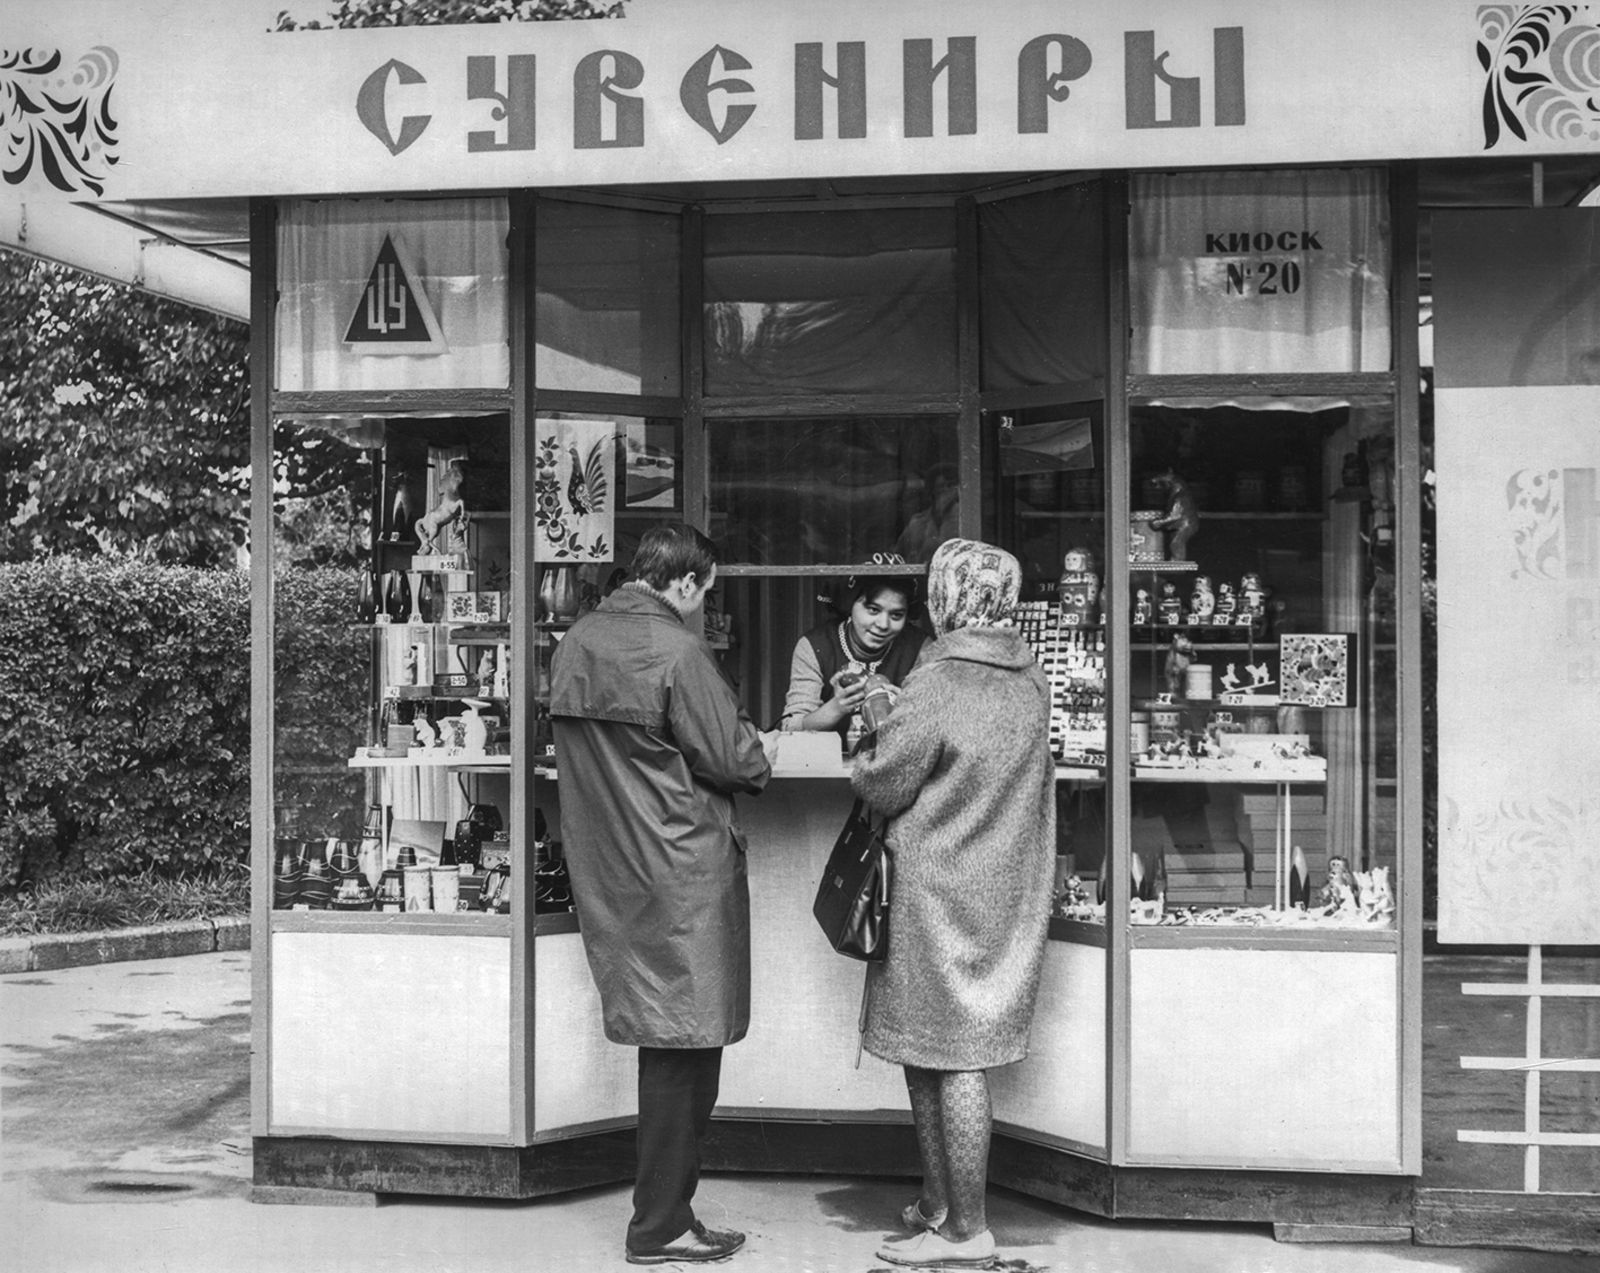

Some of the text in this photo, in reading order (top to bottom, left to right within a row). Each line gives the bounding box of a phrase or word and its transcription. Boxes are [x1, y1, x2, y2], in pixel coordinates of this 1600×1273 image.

[356, 27, 1246, 156] СУВЕНИРЫ
[1206, 230, 1323, 254] КИОСК
[1258, 261, 1300, 294] 20
